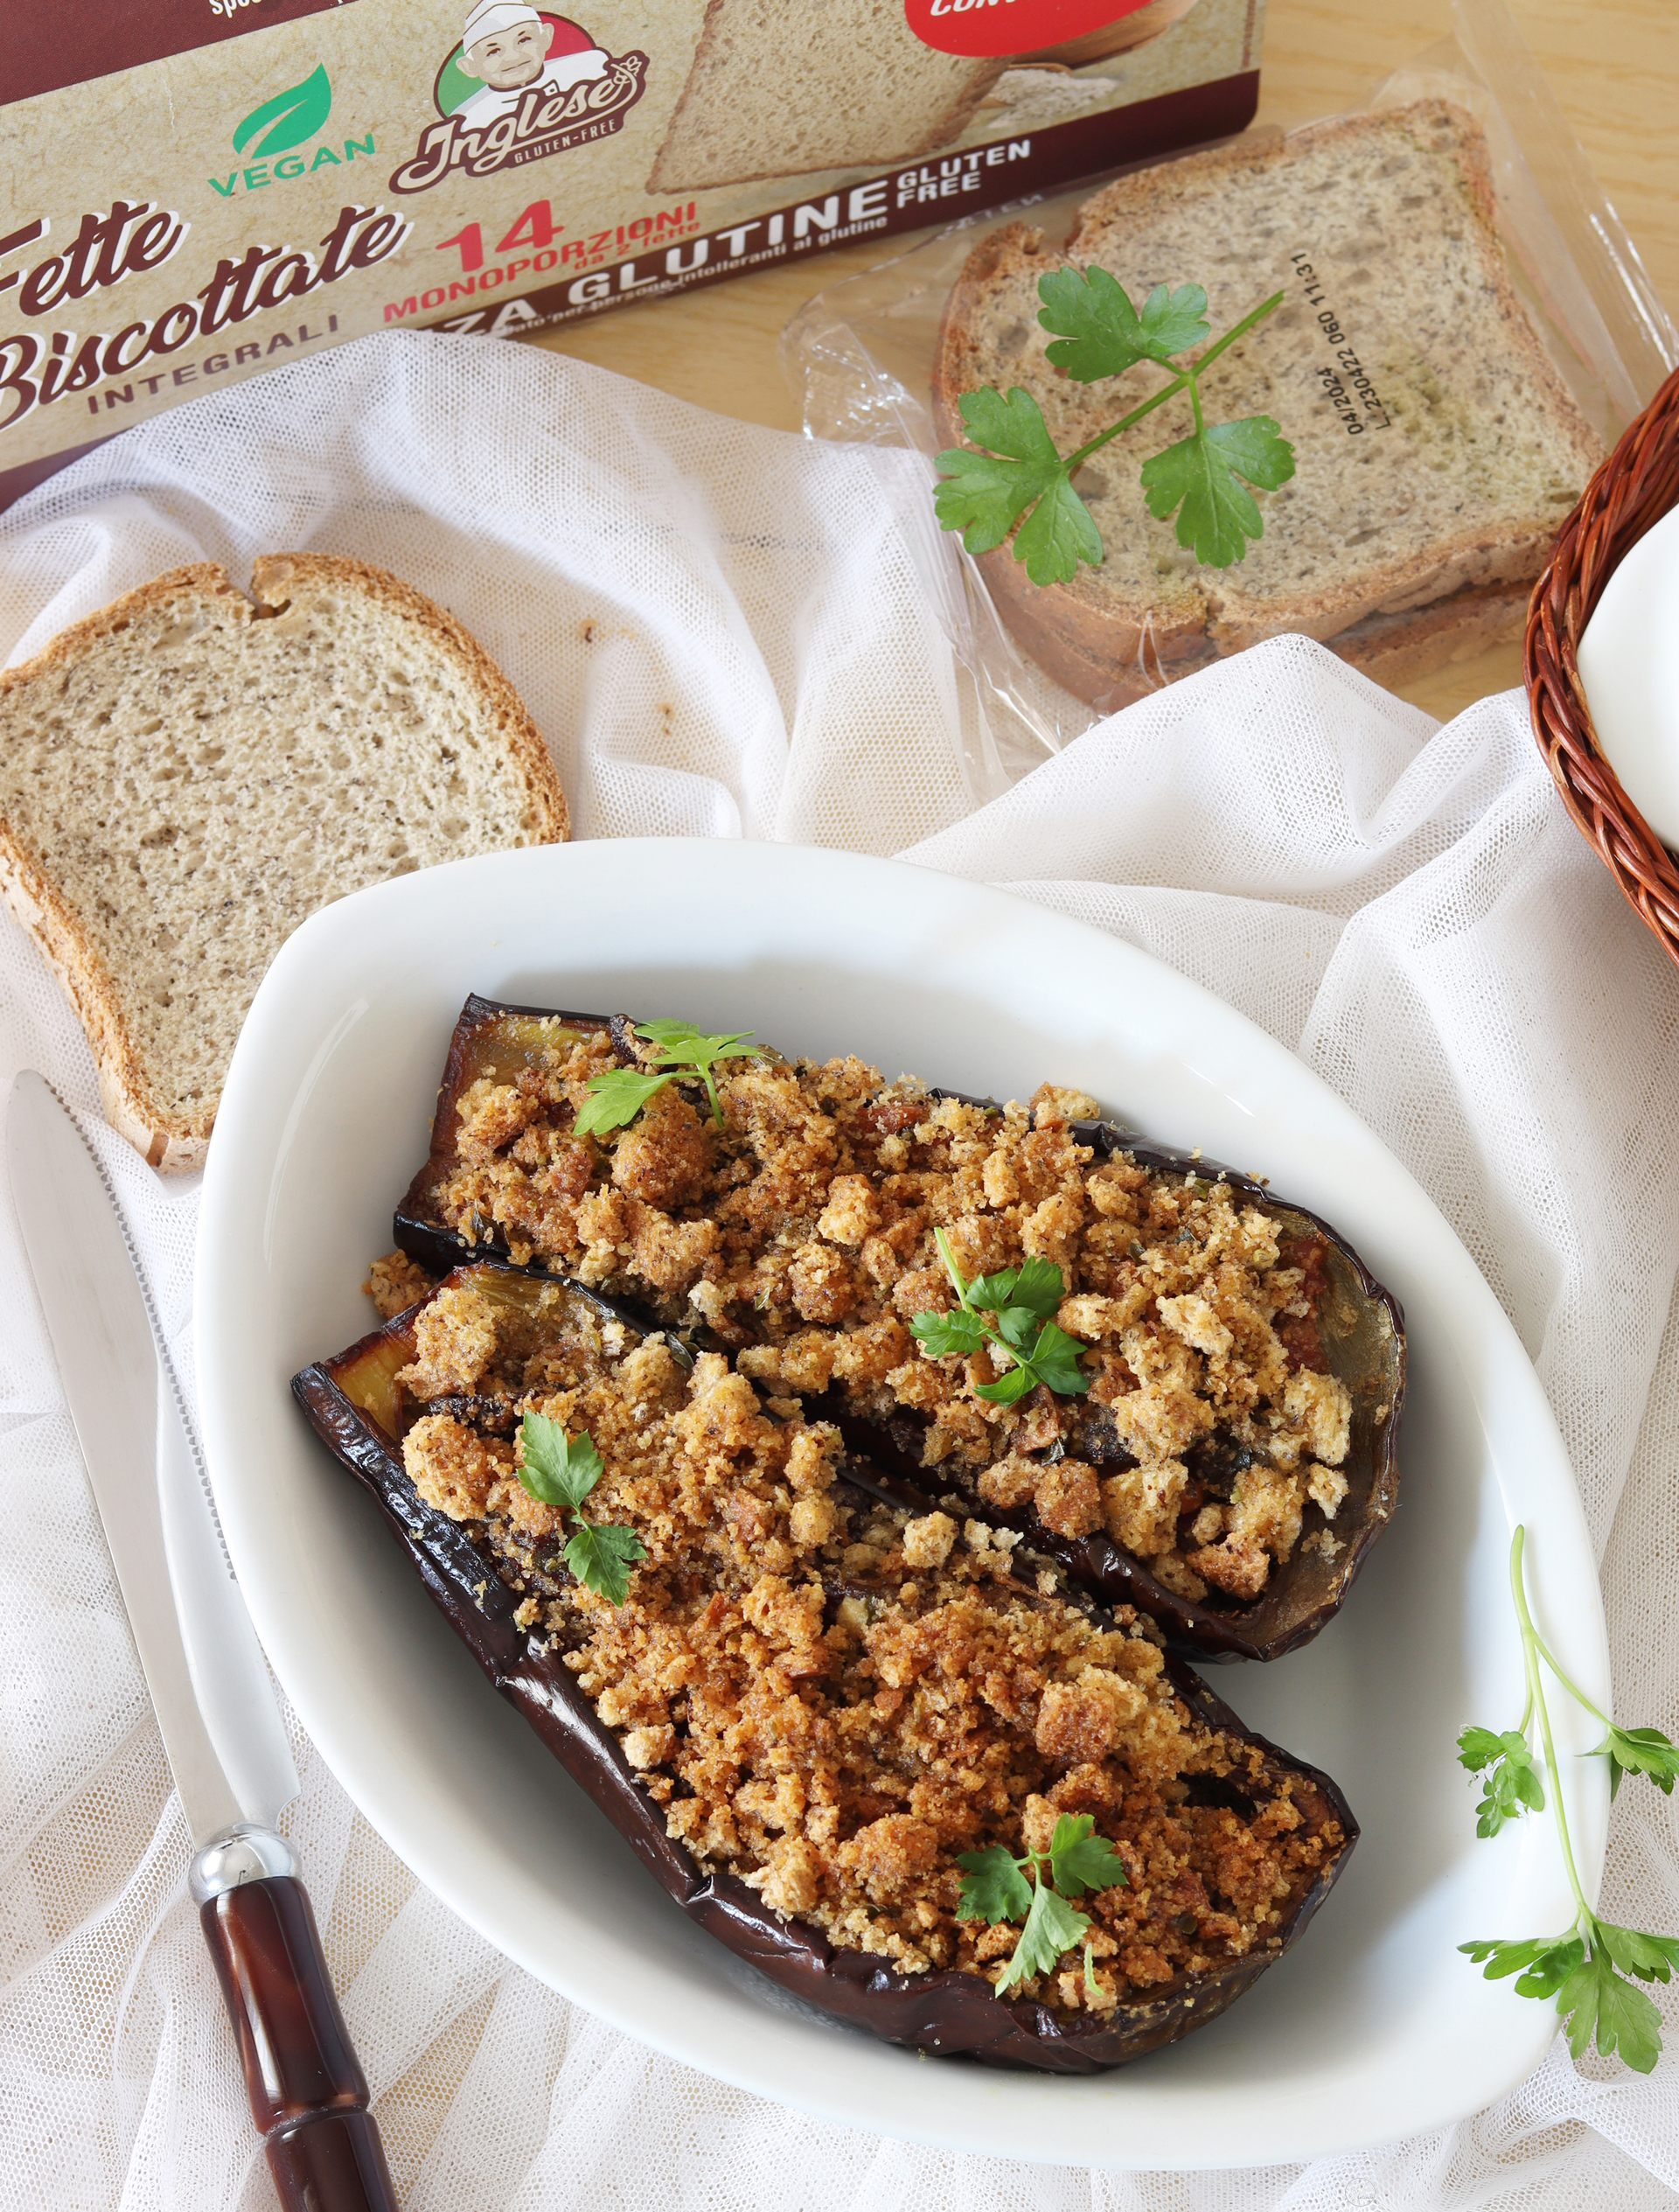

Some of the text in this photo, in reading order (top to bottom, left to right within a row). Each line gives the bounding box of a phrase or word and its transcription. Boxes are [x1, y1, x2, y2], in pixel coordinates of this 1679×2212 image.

[397, 63, 633, 190] Inglese
[514, 119, 616, 164] GLUTEN-FREE
[207, 134, 377, 198] VEGAN
[896, 140, 1031, 190] GLUTEN
[896, 171, 981, 209] FREE
[383, 202, 696, 323] MONOPORZIONI
[435, 199, 564, 272] 14
[568, 180, 888, 304] GLUTINE
[574, 222, 700, 270] da 2 fette
[792, 232, 812, 251] al
[818, 215, 888, 248] glutine
[87, 314, 339, 414] INTEGRALI
[1291, 254, 1390, 430] L.230422 060 11:31
[1318, 367, 1363, 435] 04/2024
